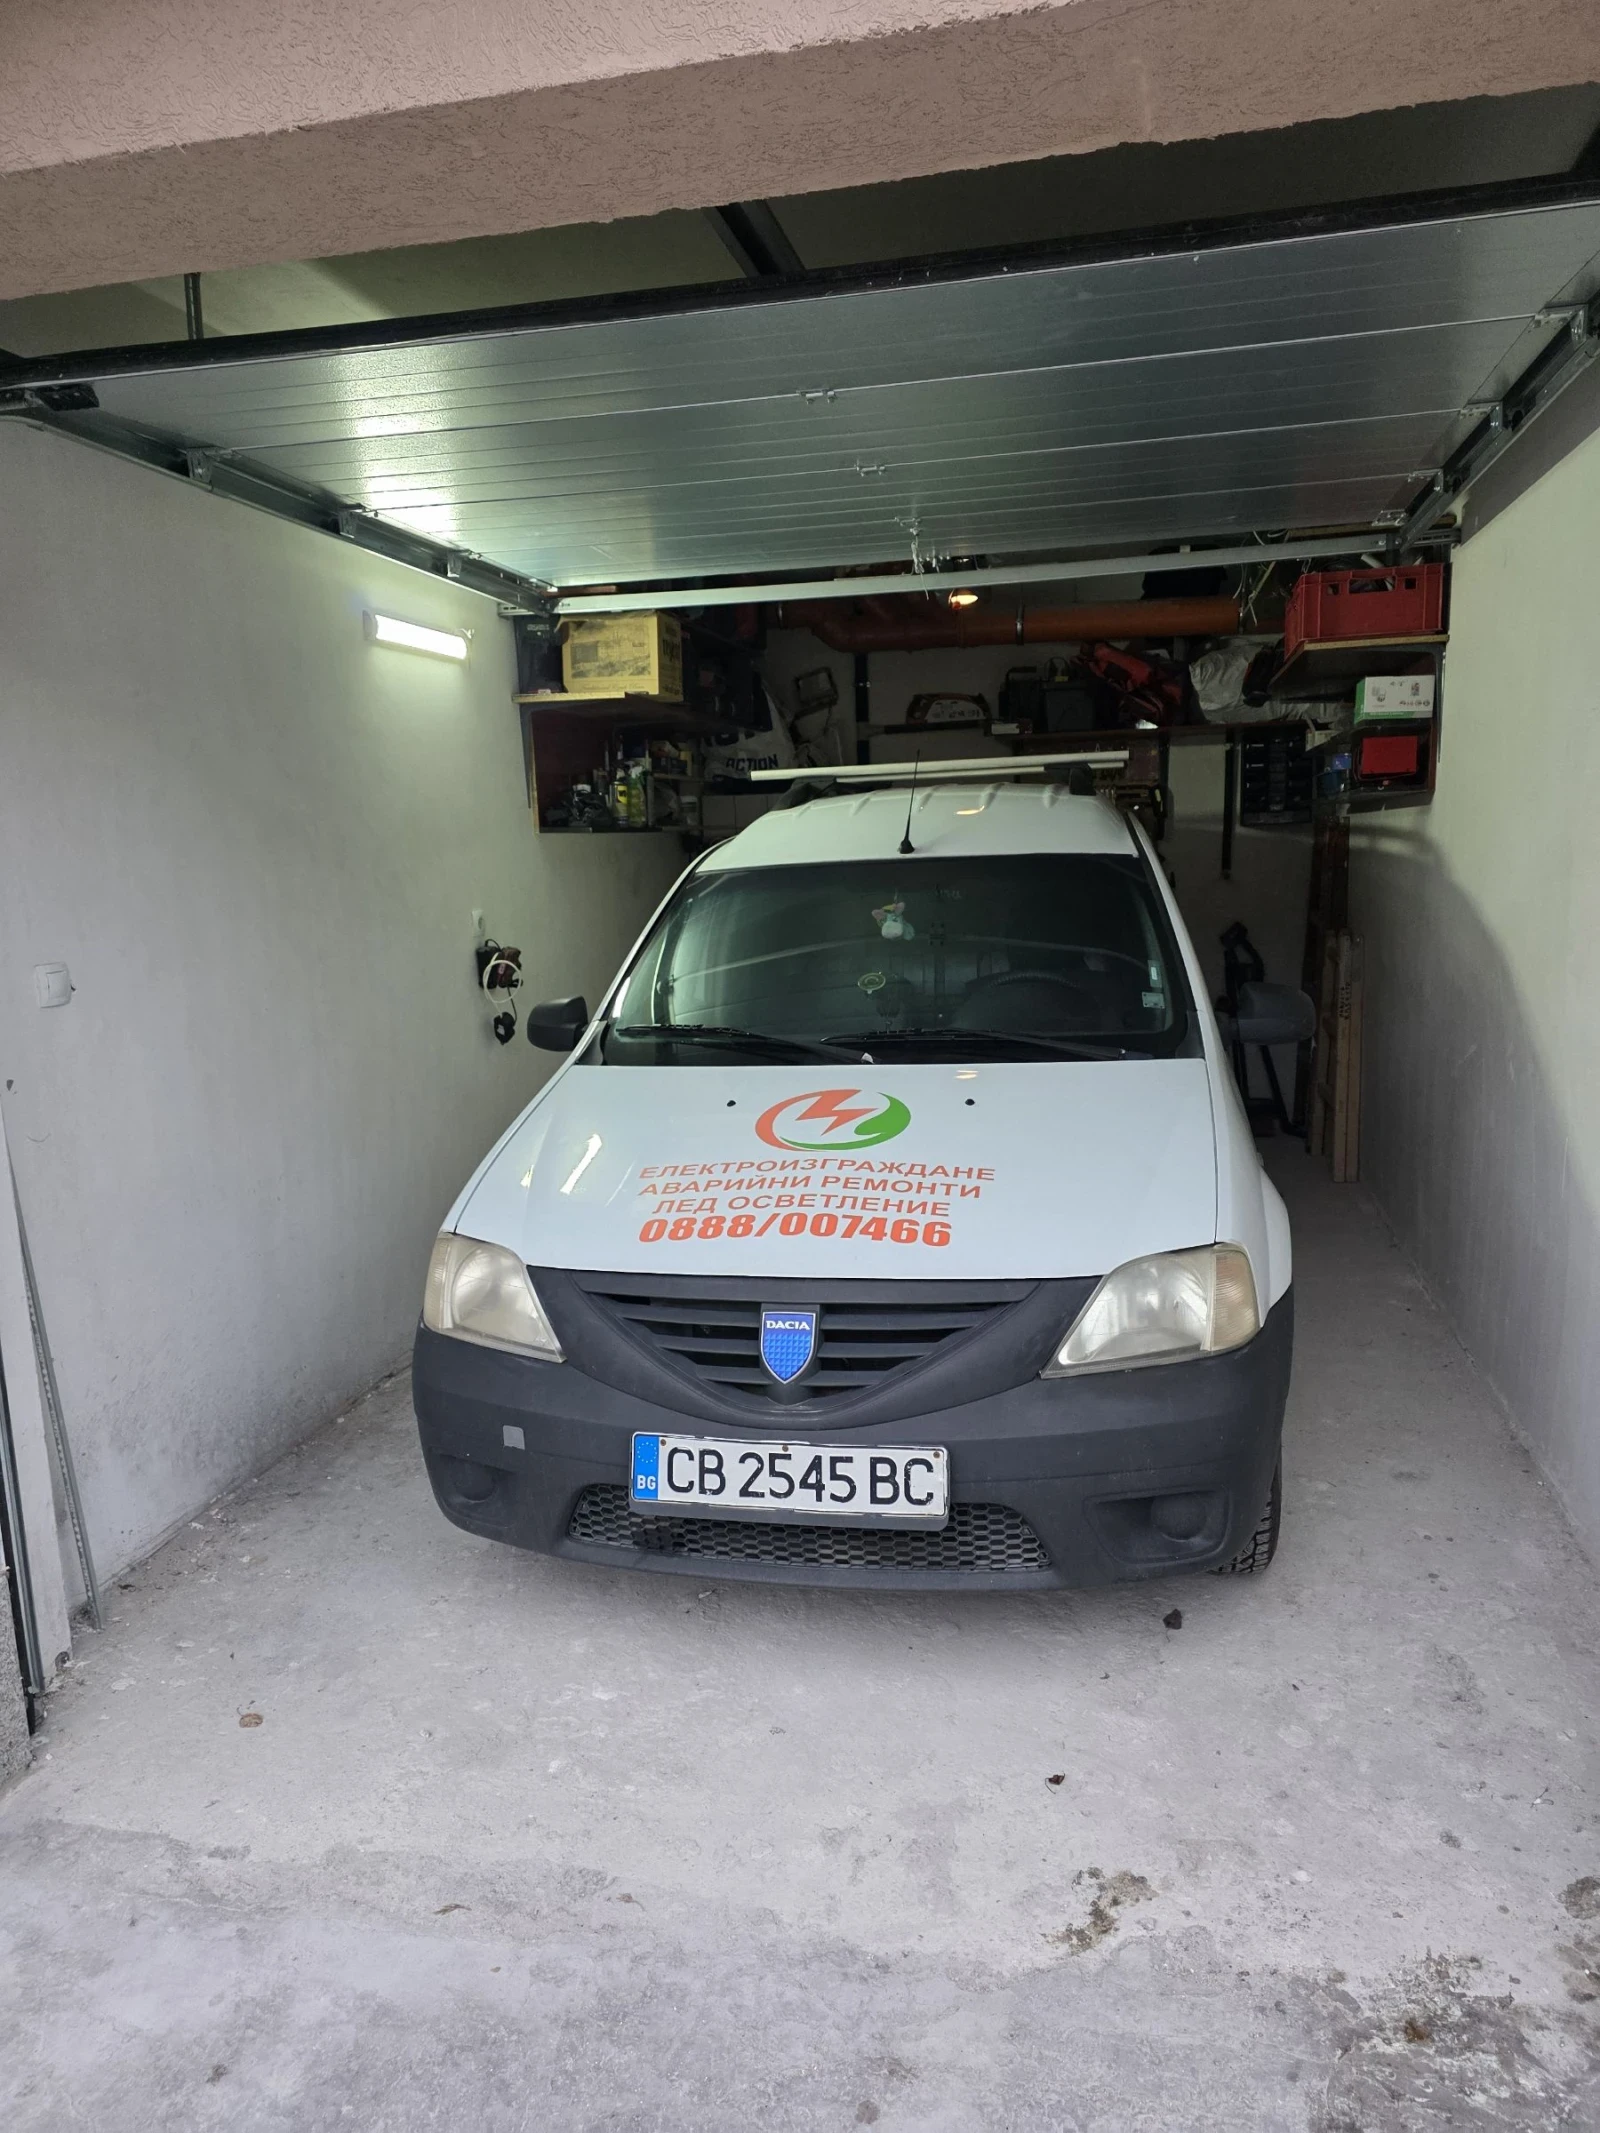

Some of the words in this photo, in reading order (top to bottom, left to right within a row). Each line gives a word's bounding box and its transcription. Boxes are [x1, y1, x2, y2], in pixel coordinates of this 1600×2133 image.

[725, 753, 779, 772] ACTION
[638, 1157, 996, 1181] ЕЛЕКТРОИЗГРАЖДАНЕ
[637, 1174, 811, 1196] АВАРИЙНИ
[820, 1175, 982, 1199] РЕМОНТИ
[651, 1198, 718, 1215] ЛЕД
[727, 1193, 951, 1217] ОСВЕТЛЕНИЕ
[638, 1212, 952, 1247] 0888/007466
[766, 1320, 811, 1331] DACIA
[636, 1475, 657, 1491] BG
[738, 1451, 858, 1504] 2545
